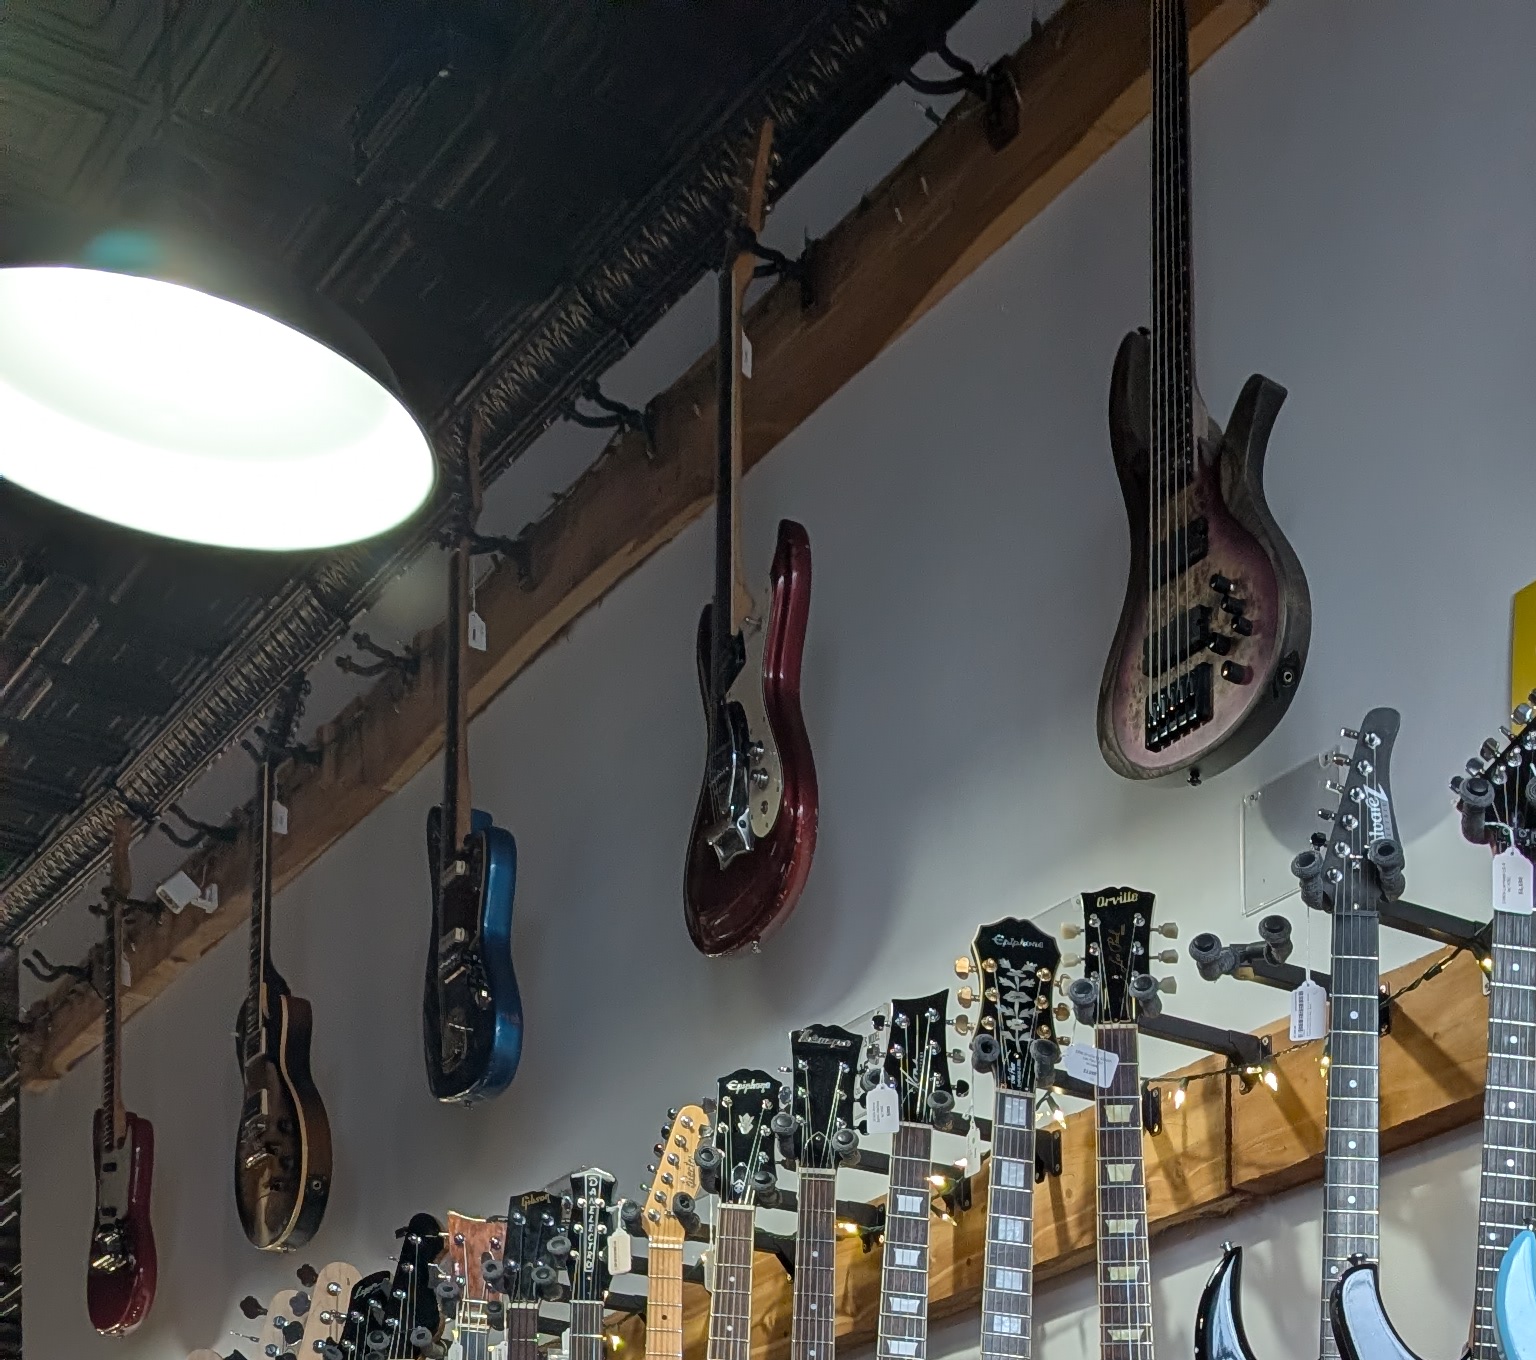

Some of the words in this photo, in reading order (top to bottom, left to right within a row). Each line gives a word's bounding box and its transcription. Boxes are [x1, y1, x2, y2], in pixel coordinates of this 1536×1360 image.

[1096, 890, 1139, 908] Orville
[991, 933, 1044, 950] Epiphone
[726, 1078, 771, 1095] Epiphone
[521, 1192, 551, 1210] Gibson
[585, 1176, 599, 1273] DANELECTRO
